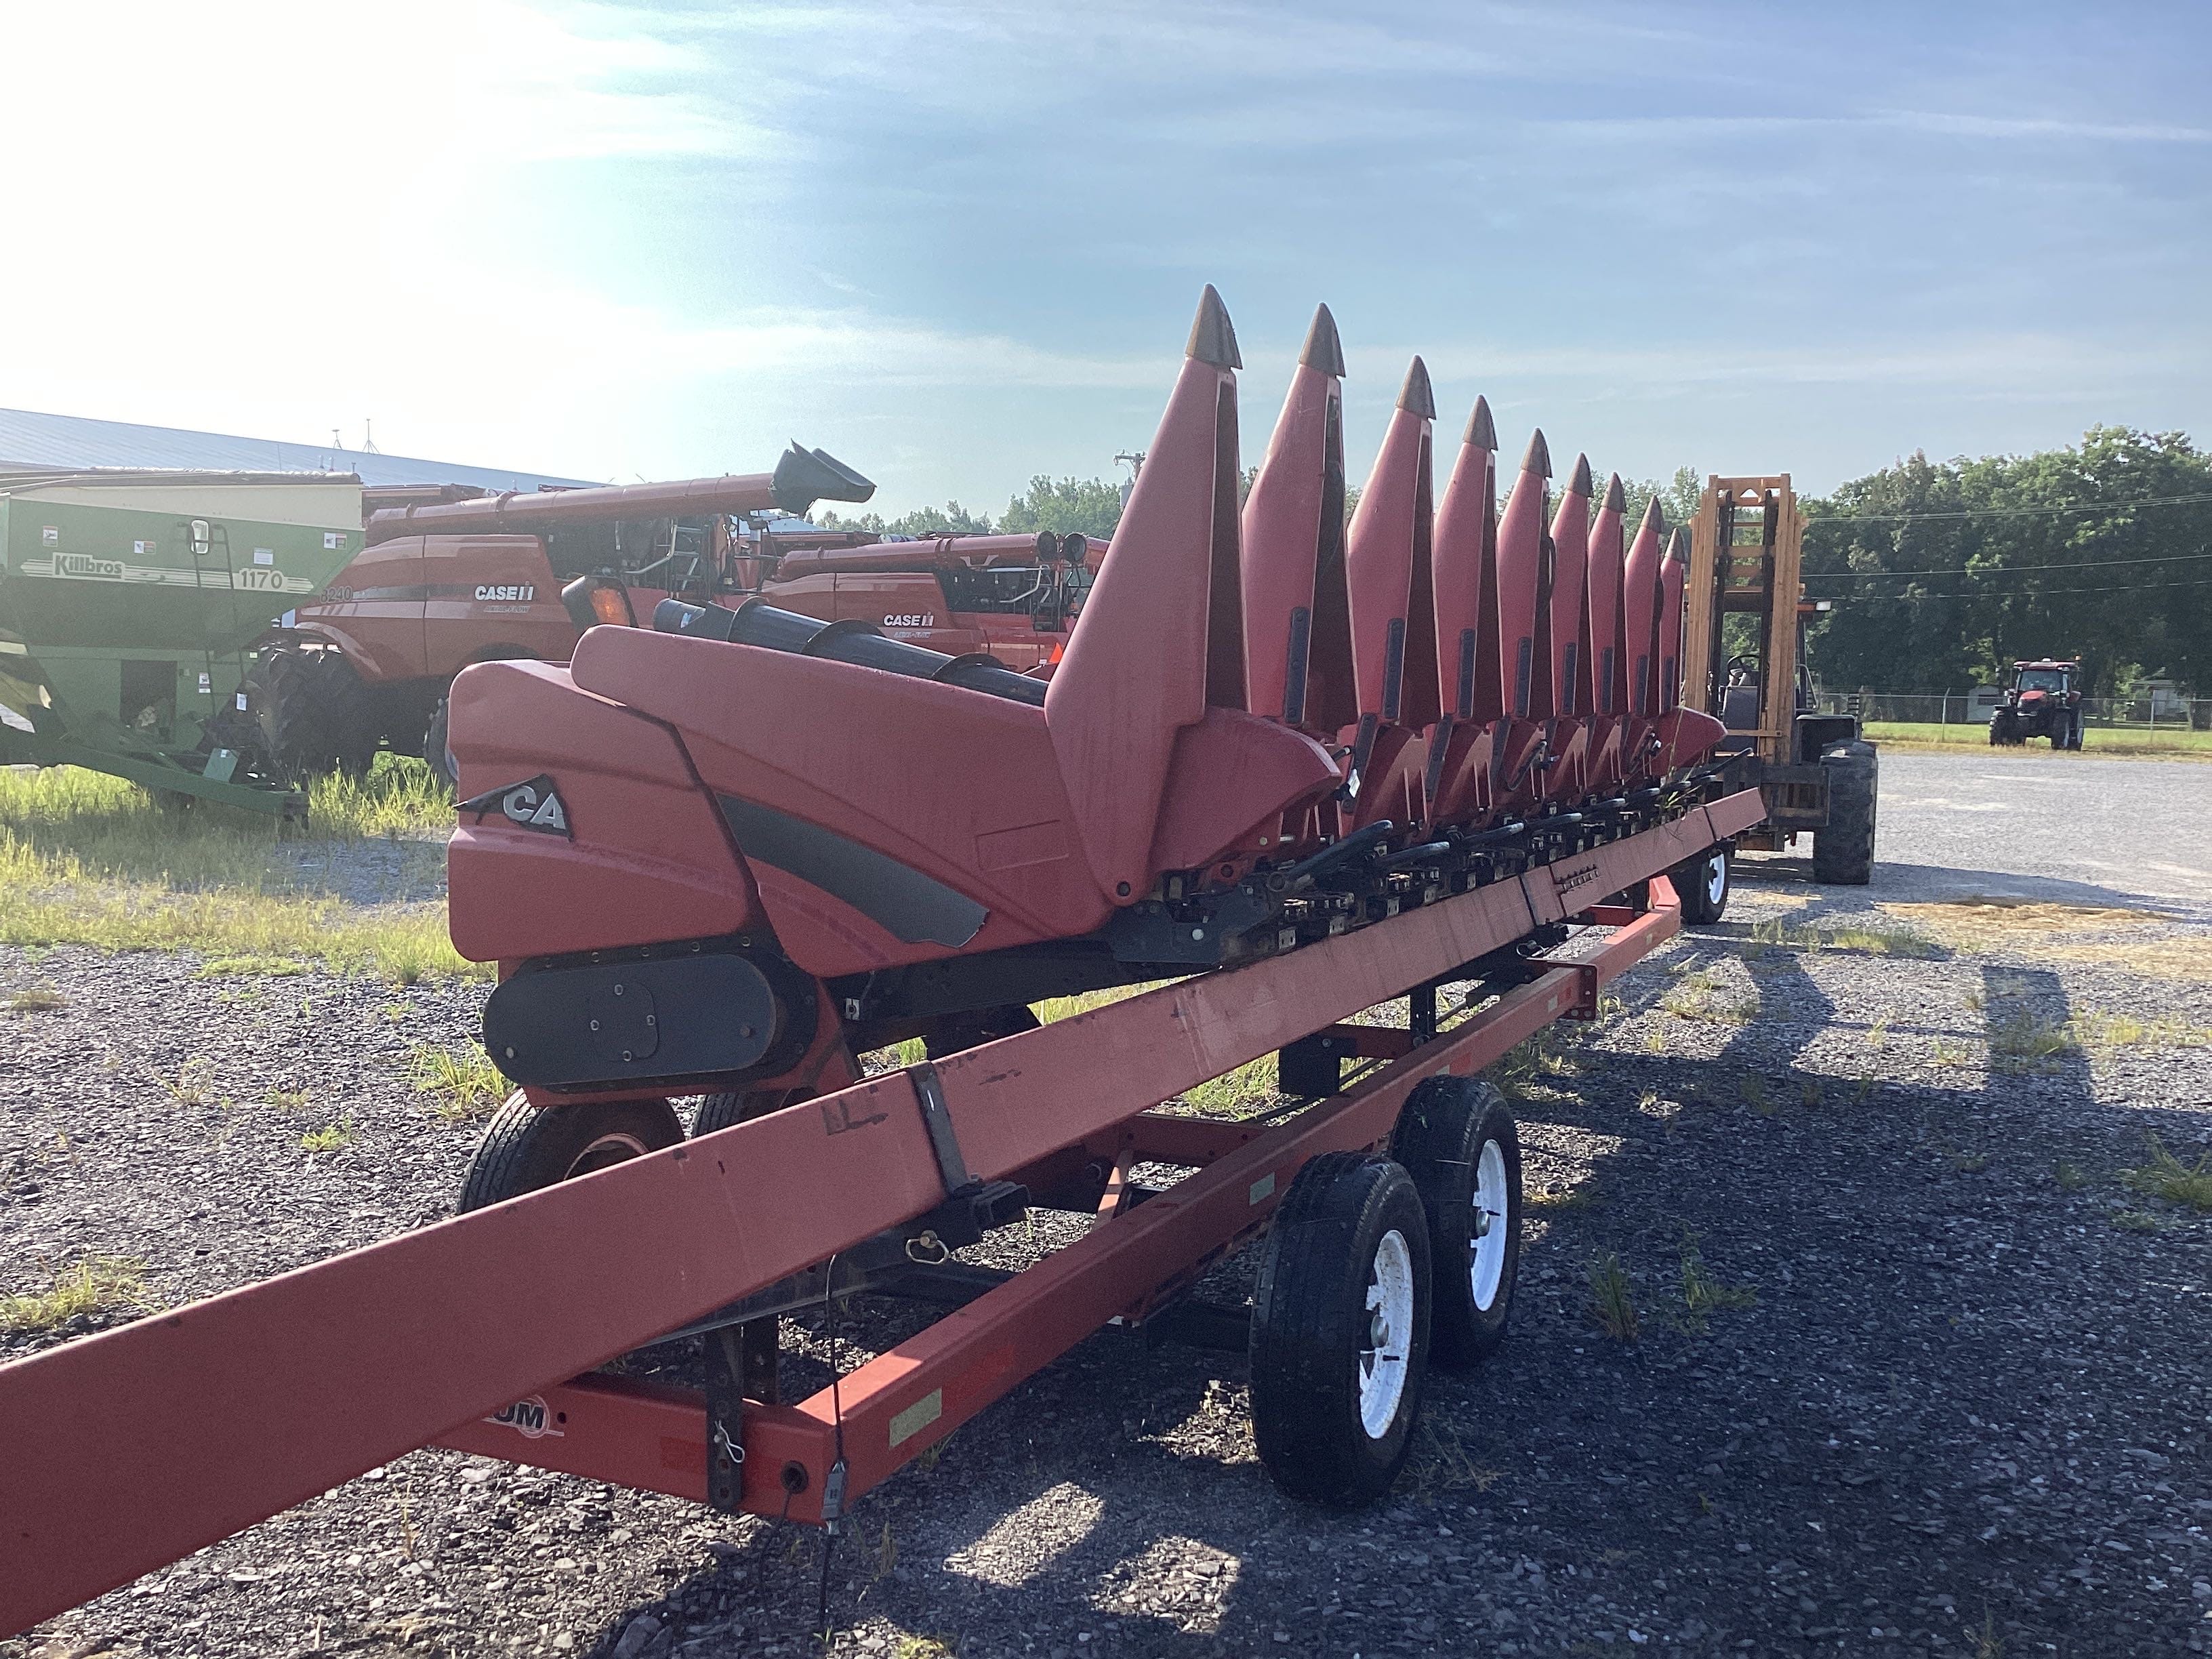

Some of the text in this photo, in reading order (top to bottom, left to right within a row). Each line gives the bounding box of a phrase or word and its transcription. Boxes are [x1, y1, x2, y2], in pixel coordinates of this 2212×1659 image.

[55, 555, 123, 575] Killbros
[241, 571, 283, 589] 1170
[475, 586, 518, 600] CASE
[884, 614, 920, 626] CASE
[503, 785, 566, 830] CA
